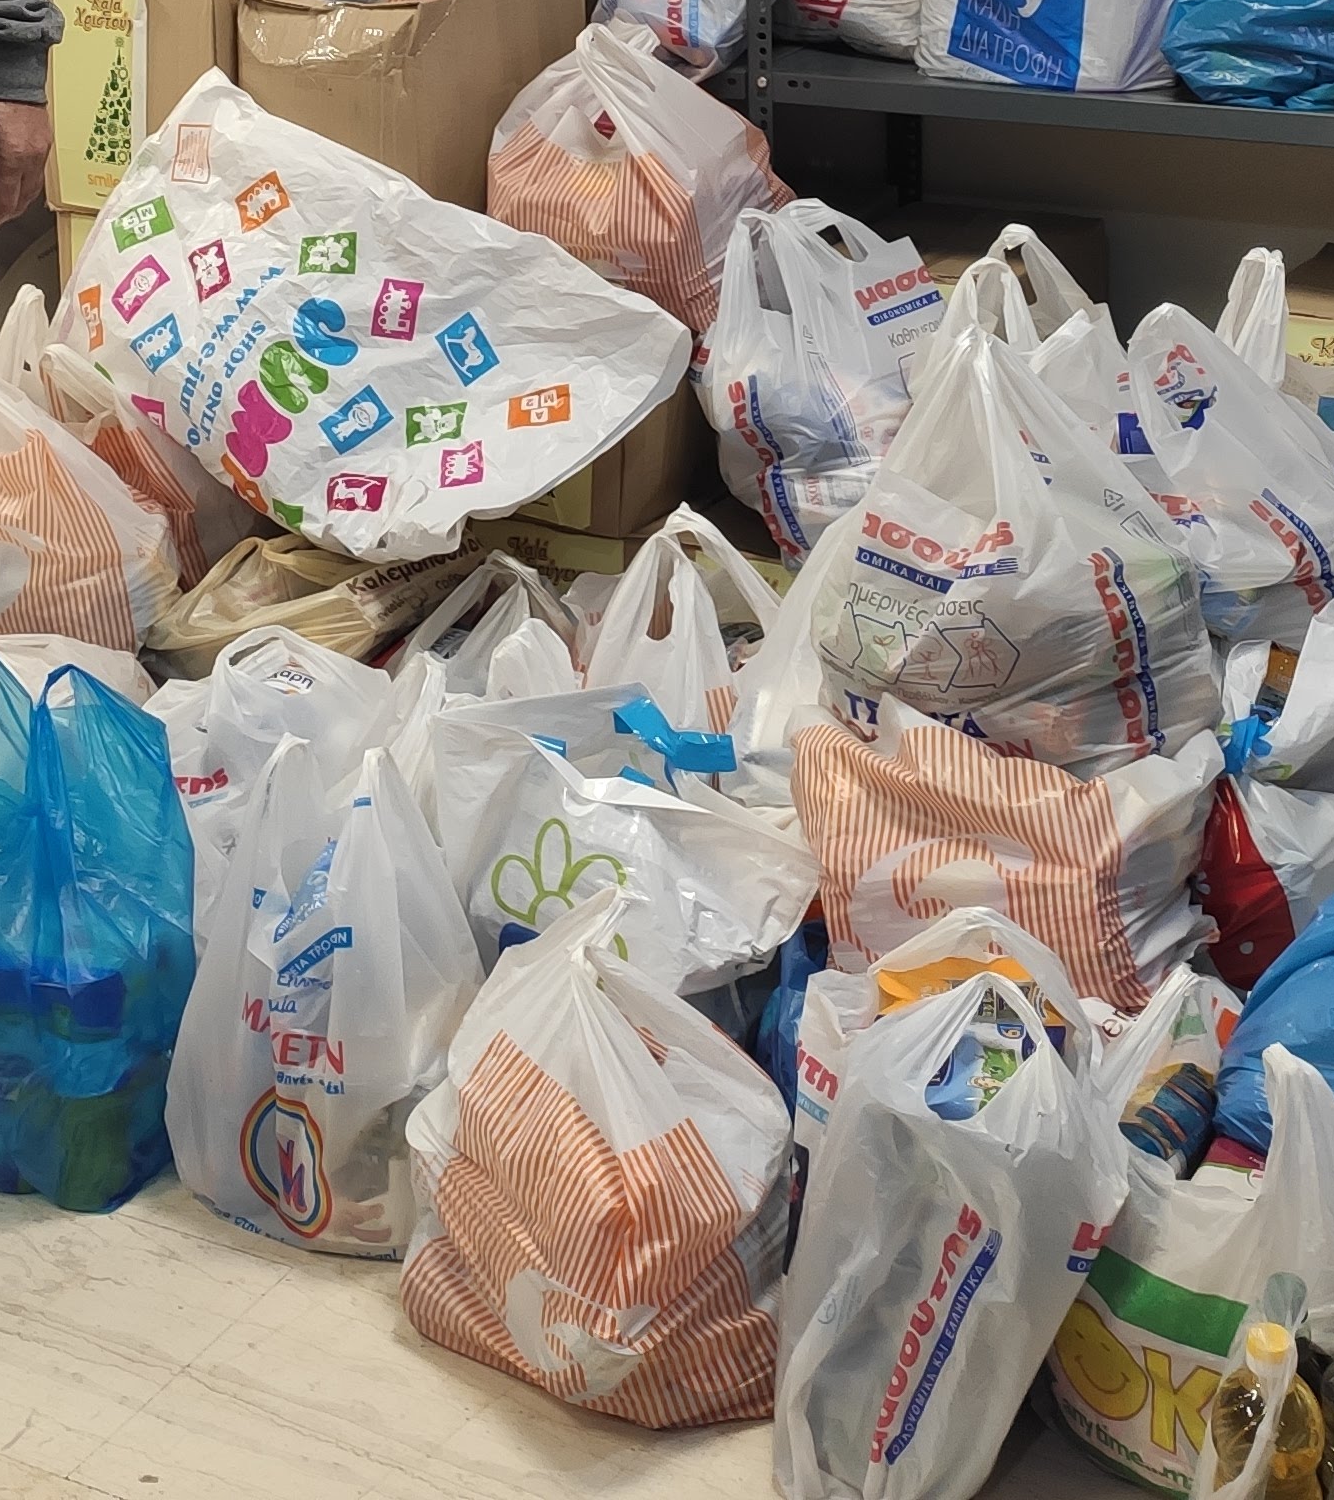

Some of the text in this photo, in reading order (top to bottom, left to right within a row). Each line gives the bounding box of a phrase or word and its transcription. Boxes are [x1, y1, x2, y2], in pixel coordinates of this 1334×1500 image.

[959, 23, 1062, 86] ΔΙΑΤΡΟΦΗ
[872, 297, 929, 324] ΟΙΚΟΝΟΜΙΚΑ
[225, 319, 267, 379] SHOP
[848, 583, 929, 630] ημερινές
[916, 572, 943, 592] ΚΑΙ
[932, 1344, 949, 1368] ΚΑΙ
[943, 1263, 986, 1340] ΕΛΛΗΝΙΚΑ
